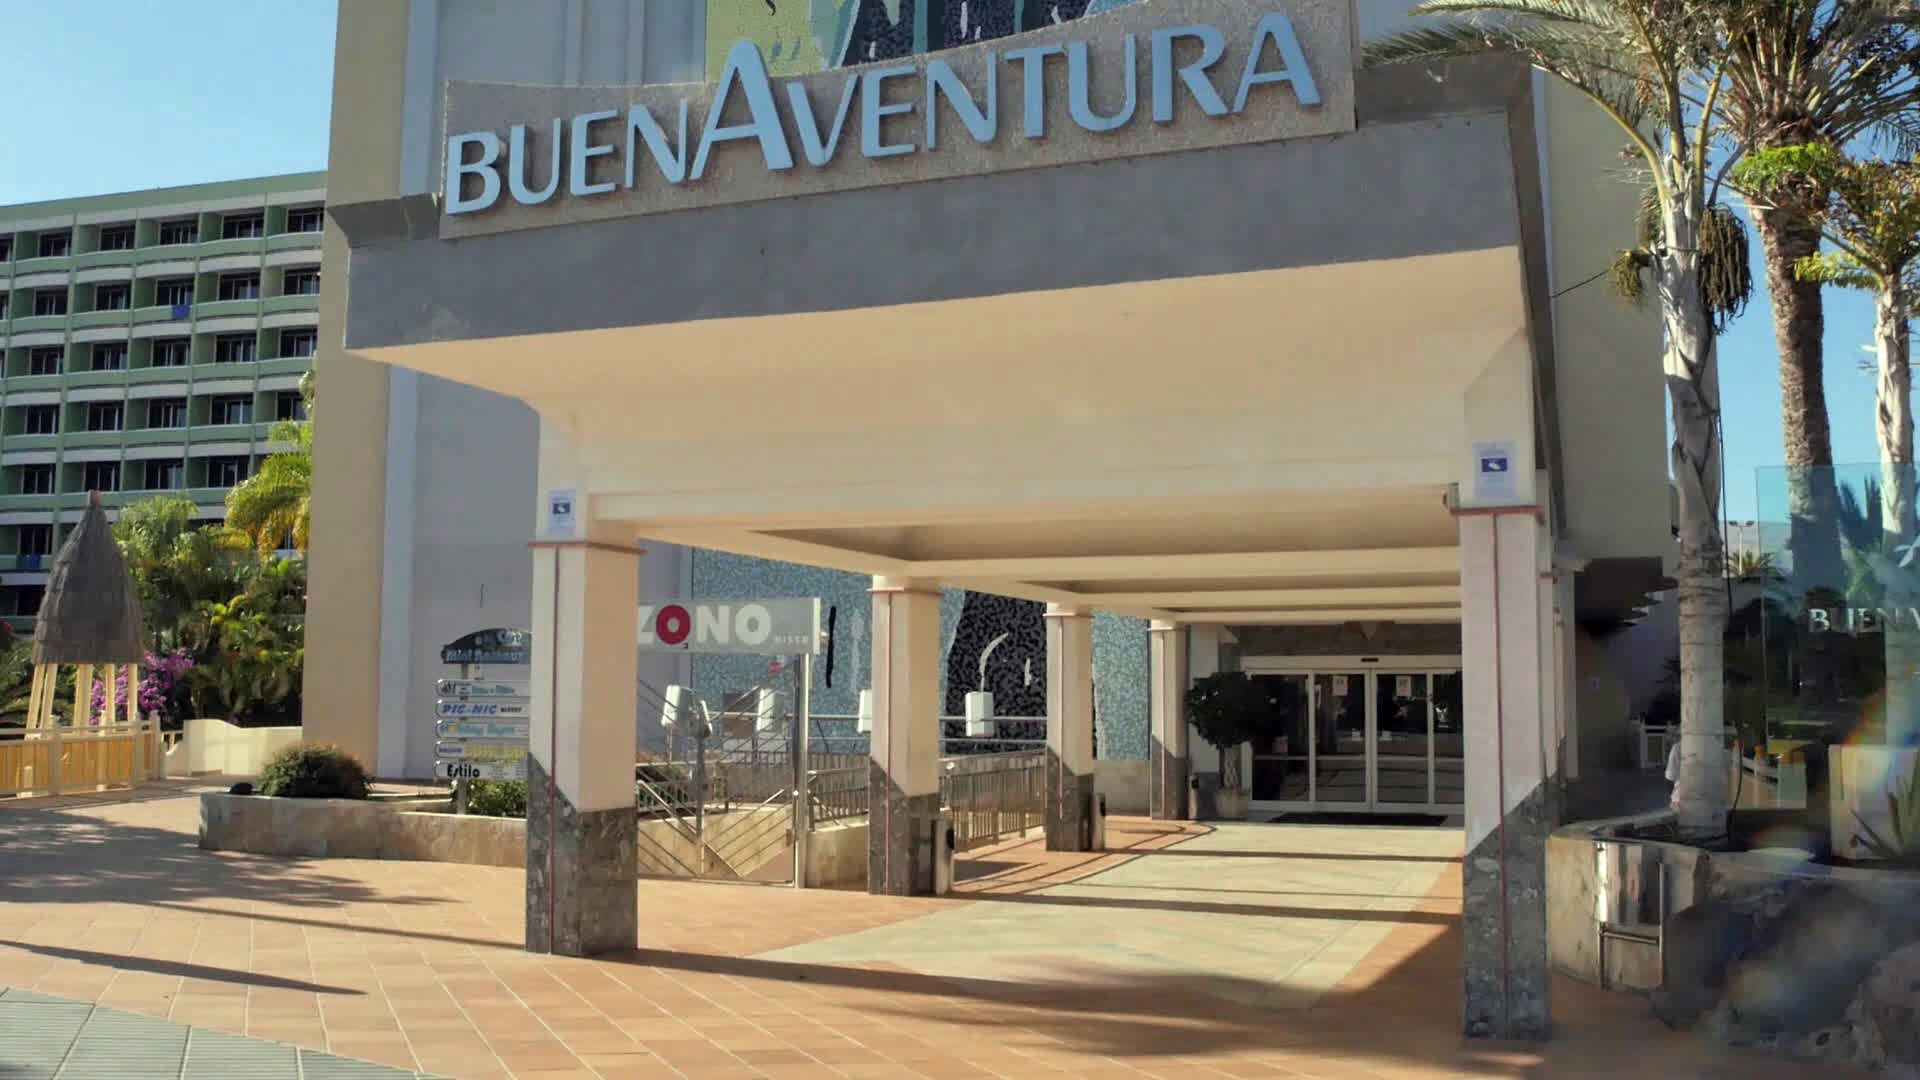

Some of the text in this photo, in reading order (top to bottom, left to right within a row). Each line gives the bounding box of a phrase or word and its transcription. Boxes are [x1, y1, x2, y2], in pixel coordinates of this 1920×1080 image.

[444, 12, 1322, 215] BUENAVENTURA
[443, 704, 497, 715] PIC-NIC
[447, 764, 480, 778] Estilo
